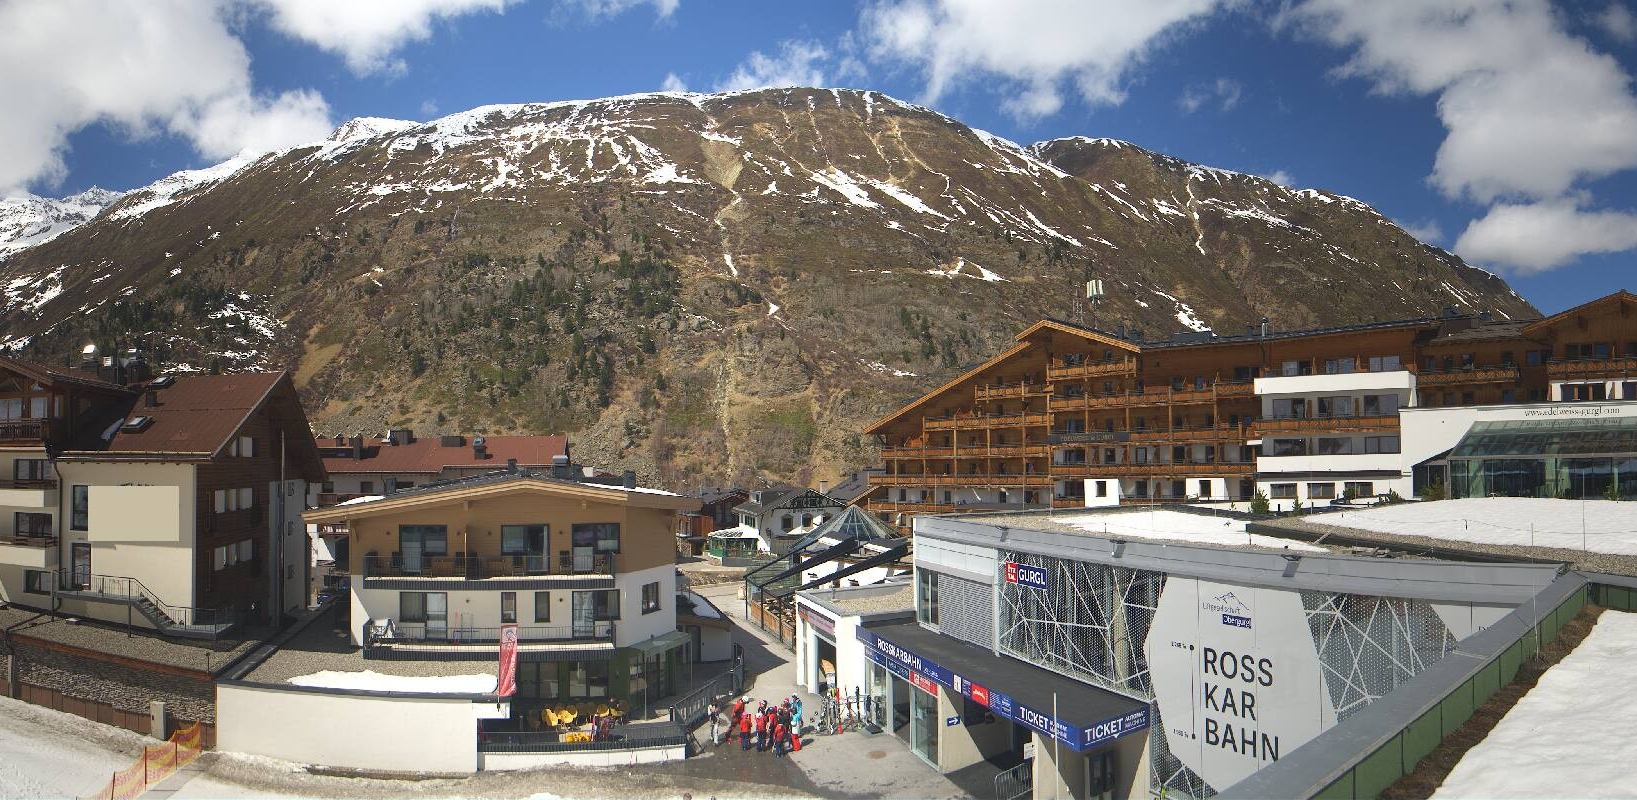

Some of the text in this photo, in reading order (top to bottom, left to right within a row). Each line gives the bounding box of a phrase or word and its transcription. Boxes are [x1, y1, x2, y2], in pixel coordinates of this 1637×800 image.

[1019, 569, 1046, 586] GURGL
[877, 638, 922, 671] ROSSKARBAHN
[1203, 646, 1273, 687] ROSS
[1020, 706, 1049, 730] TICKET
[1204, 682, 1257, 721] KAR
[1084, 717, 1124, 742] TICKET
[1205, 717, 1279, 762] BAHN
